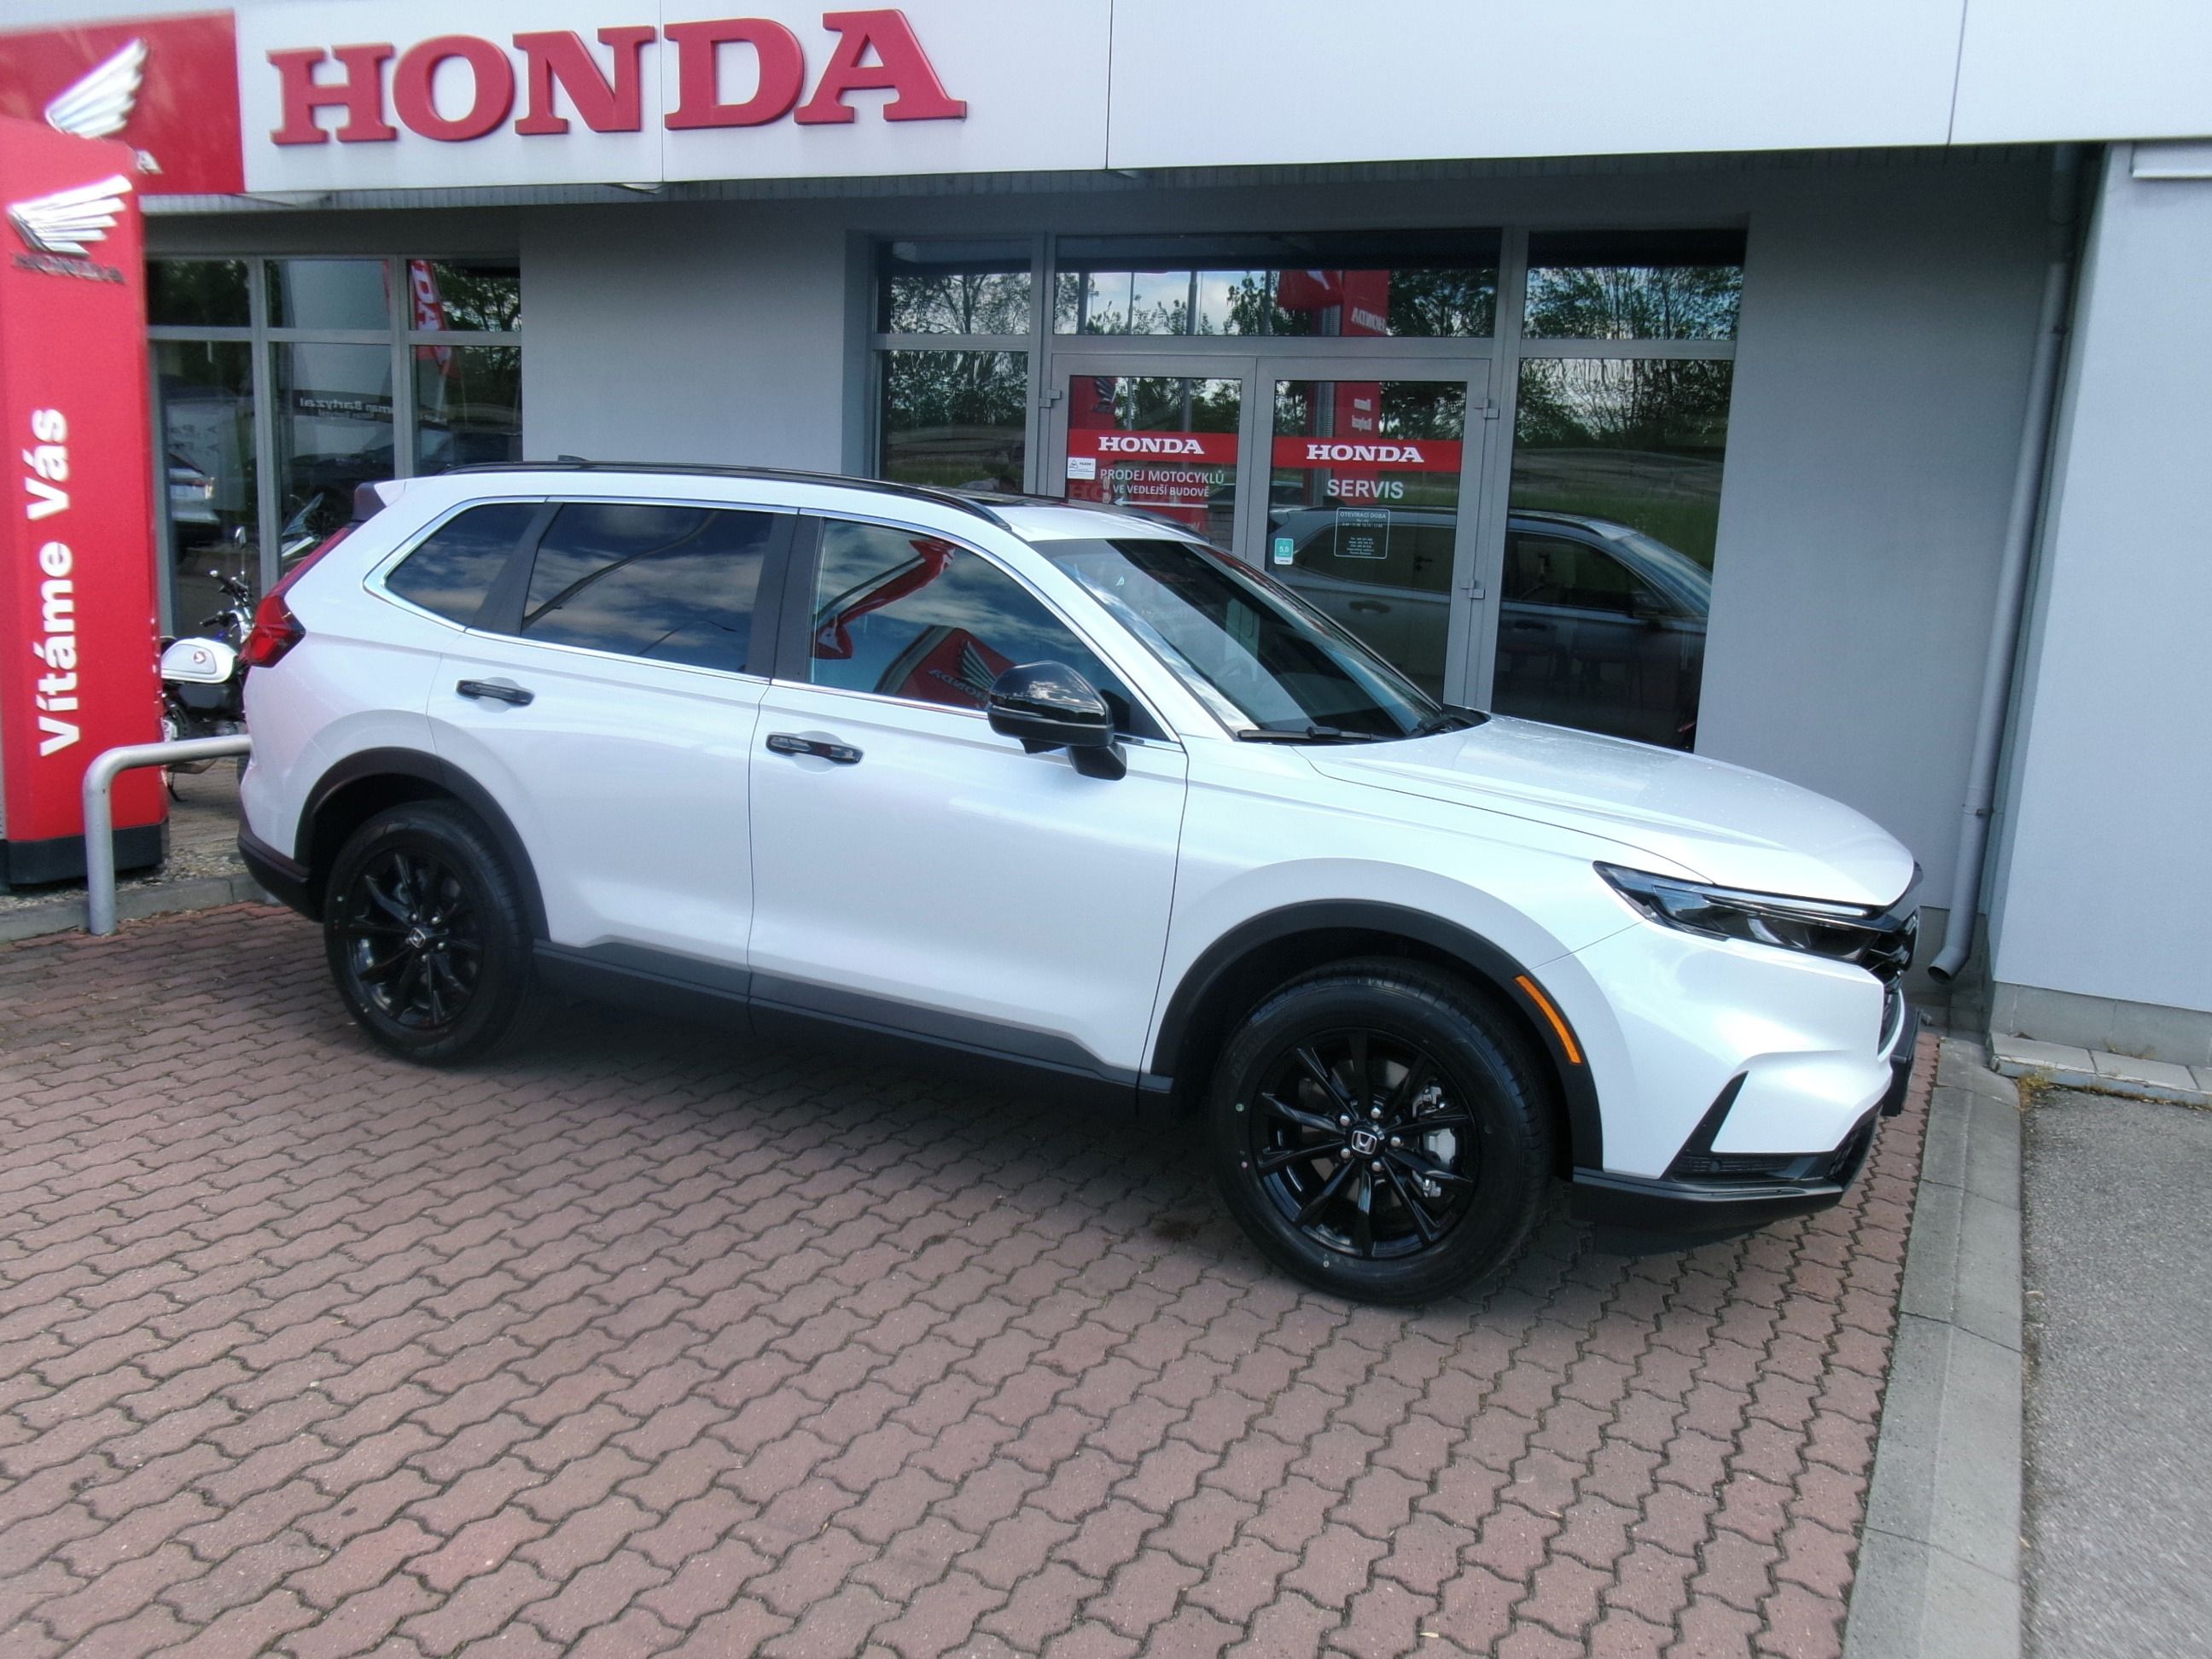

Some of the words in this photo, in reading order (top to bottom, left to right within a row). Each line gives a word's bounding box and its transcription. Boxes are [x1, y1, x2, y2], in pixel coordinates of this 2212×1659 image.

[265, 9, 967, 144] HONDA
[1098, 436, 1205, 455] HONDA
[1306, 444, 1425, 463] HONDA
[22, 408, 70, 521] Vás
[1100, 469, 1144, 481] PRODEJ
[1148, 469, 1225, 485] MOTOCYKLŮ
[1113, 484, 1125, 493] VE
[1126, 484, 1167, 496] VEDLEJŠÍ
[1170, 486, 1209, 497] BUDOVĚ
[1326, 479, 1404, 499] SERVIS
[33, 541, 81, 757] Vítáme
